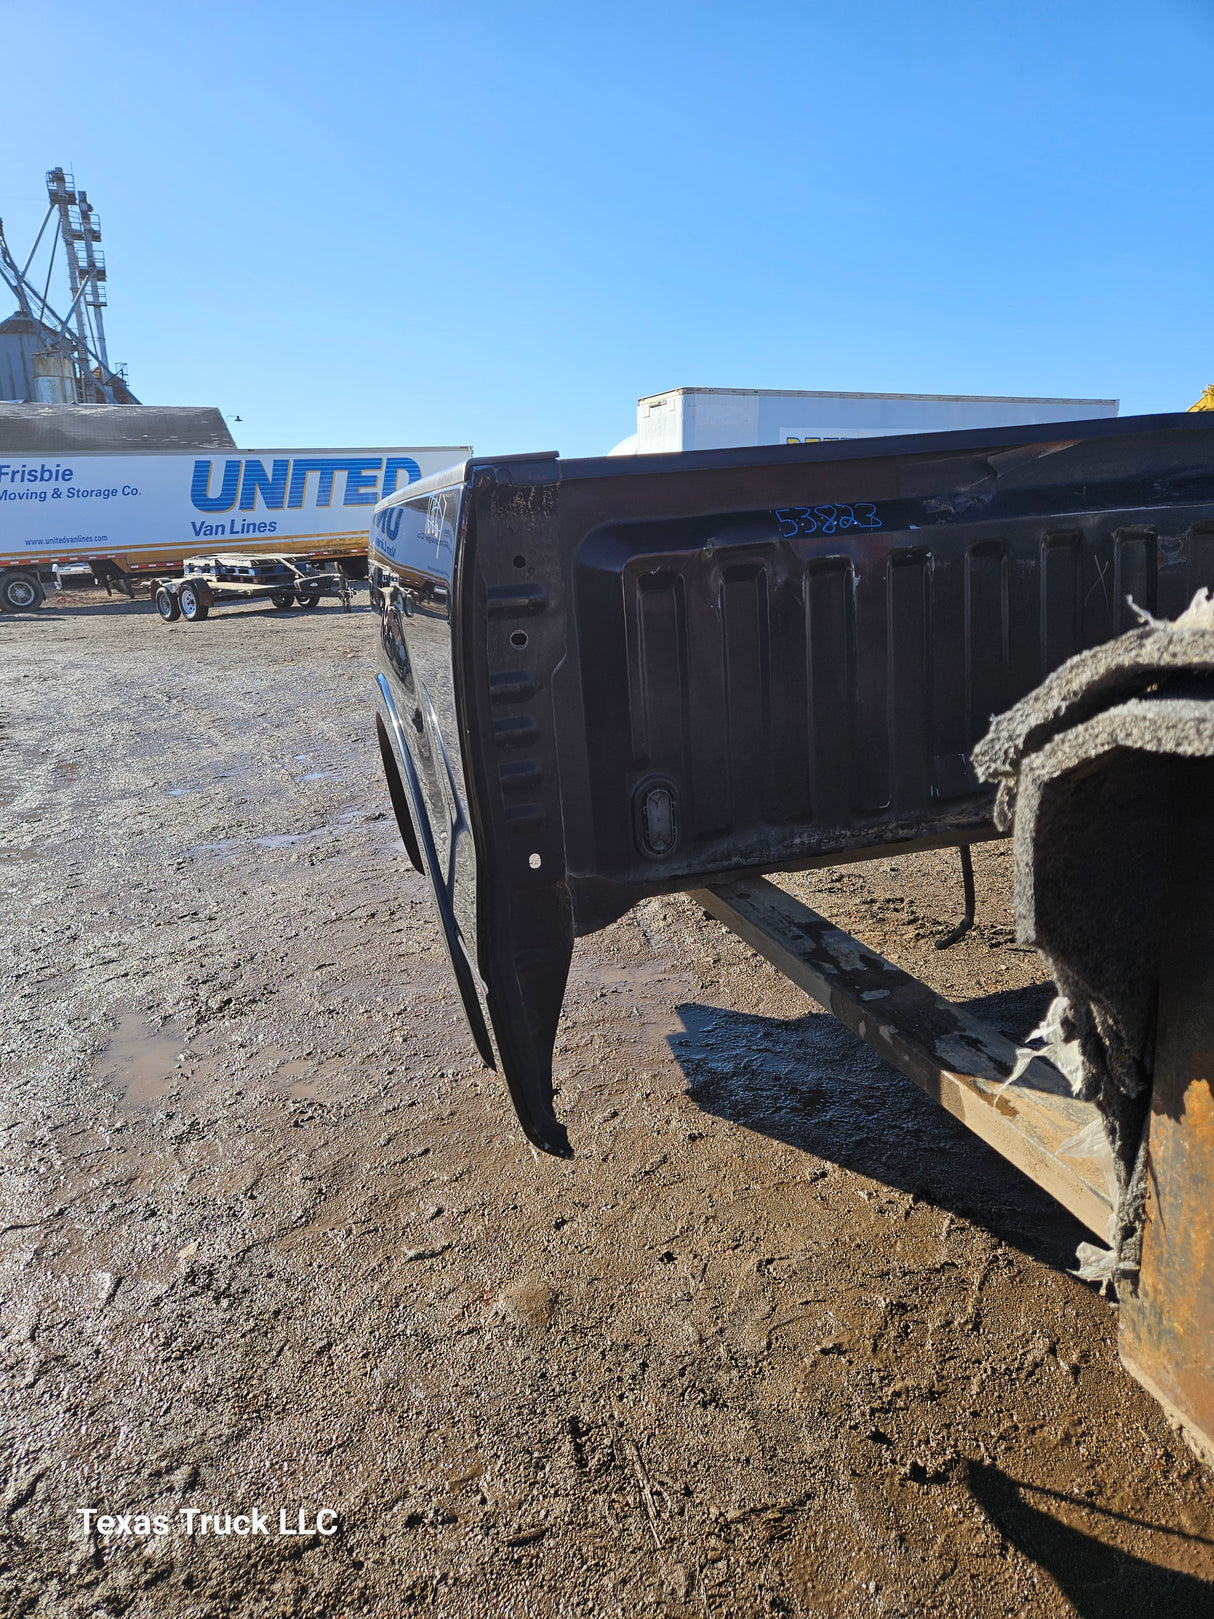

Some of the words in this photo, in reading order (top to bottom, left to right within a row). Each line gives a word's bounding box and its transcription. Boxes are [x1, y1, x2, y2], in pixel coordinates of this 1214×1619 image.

[0, 464, 74, 483] Frisbie
[51, 487, 62, 499] &
[66, 487, 118, 499] Storage
[121, 485, 142, 496] Co.
[190, 457, 423, 514] UNITED
[190, 520, 226, 537] Van
[229, 518, 278, 535] Lines
[775, 503, 882, 537] 53823
[25, 534, 108, 546] www.unitedvanlines.com
